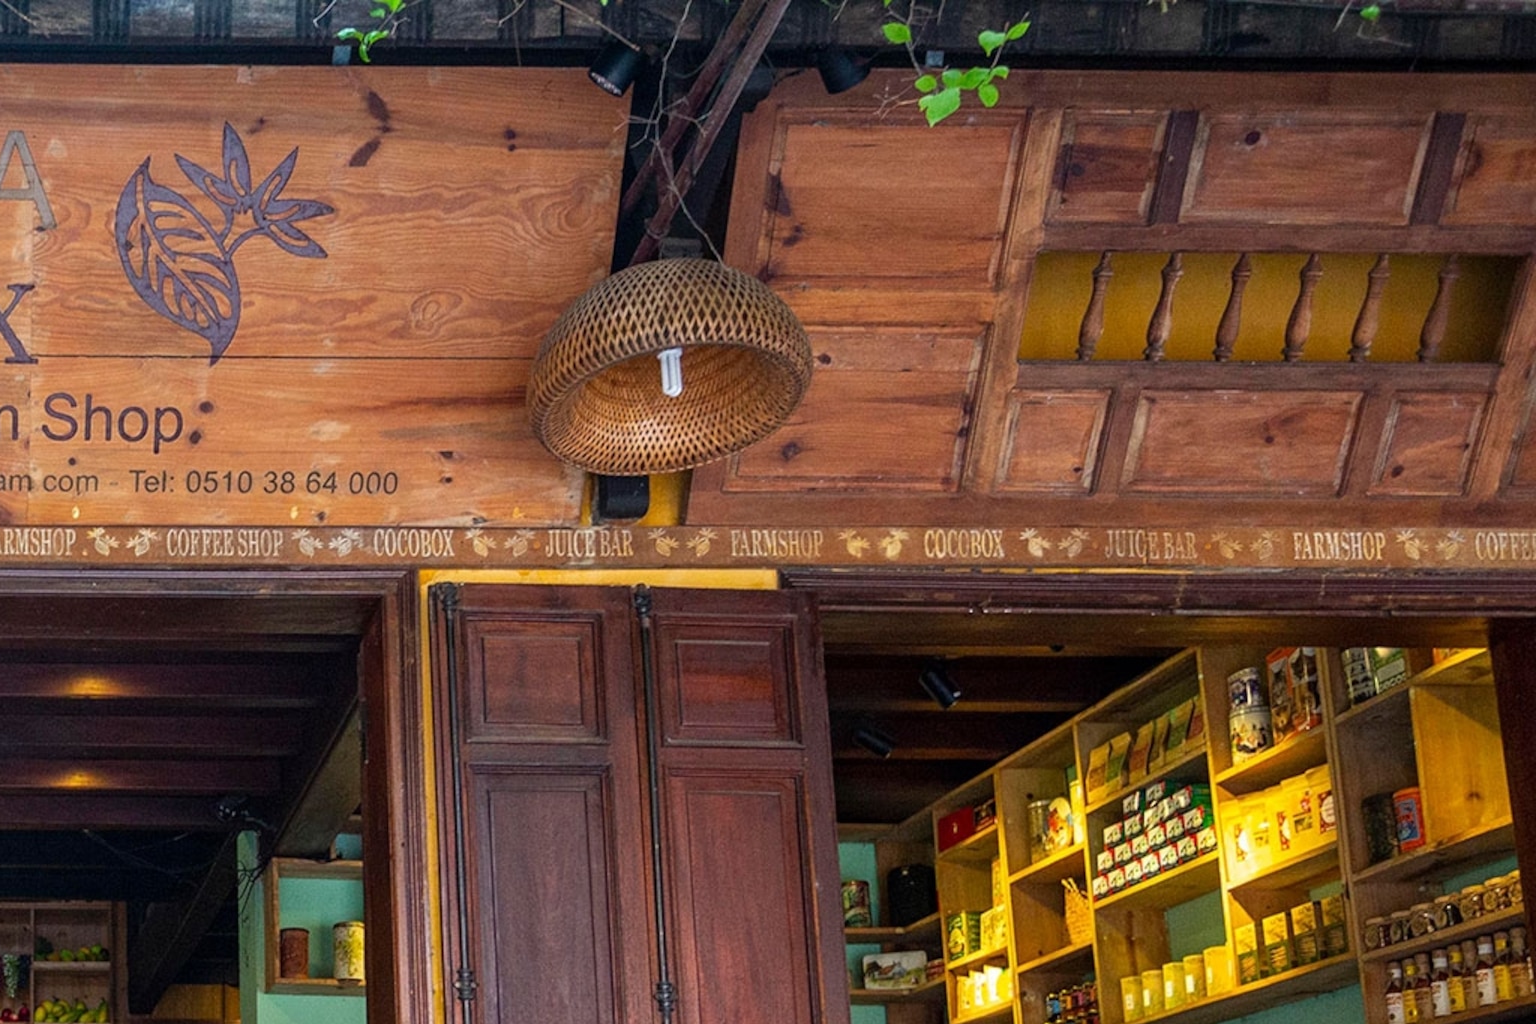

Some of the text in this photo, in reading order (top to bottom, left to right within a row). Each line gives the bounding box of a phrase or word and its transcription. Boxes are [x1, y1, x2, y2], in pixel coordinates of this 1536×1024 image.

[41, 392, 184, 454] Shop
[129, 470, 174, 493] Tel:
[185, 470, 252, 495] 0510
[263, 470, 296, 495] 38
[305, 471, 338, 495] 64
[348, 471, 399, 495] 000
[166, 528, 235, 558] COFFEE
[237, 528, 285, 558] SHOP
[373, 528, 456, 558] COCOBOX
[545, 529, 596, 559] JUICE
[599, 529, 635, 559] BAR
[730, 529, 824, 559] FARMSHOP
[923, 529, 1005, 559] COCOBOX
[1104, 529, 1163, 560] JUICE
[1164, 529, 1198, 560] BAR
[1293, 530, 1387, 560] FARMSHOP
